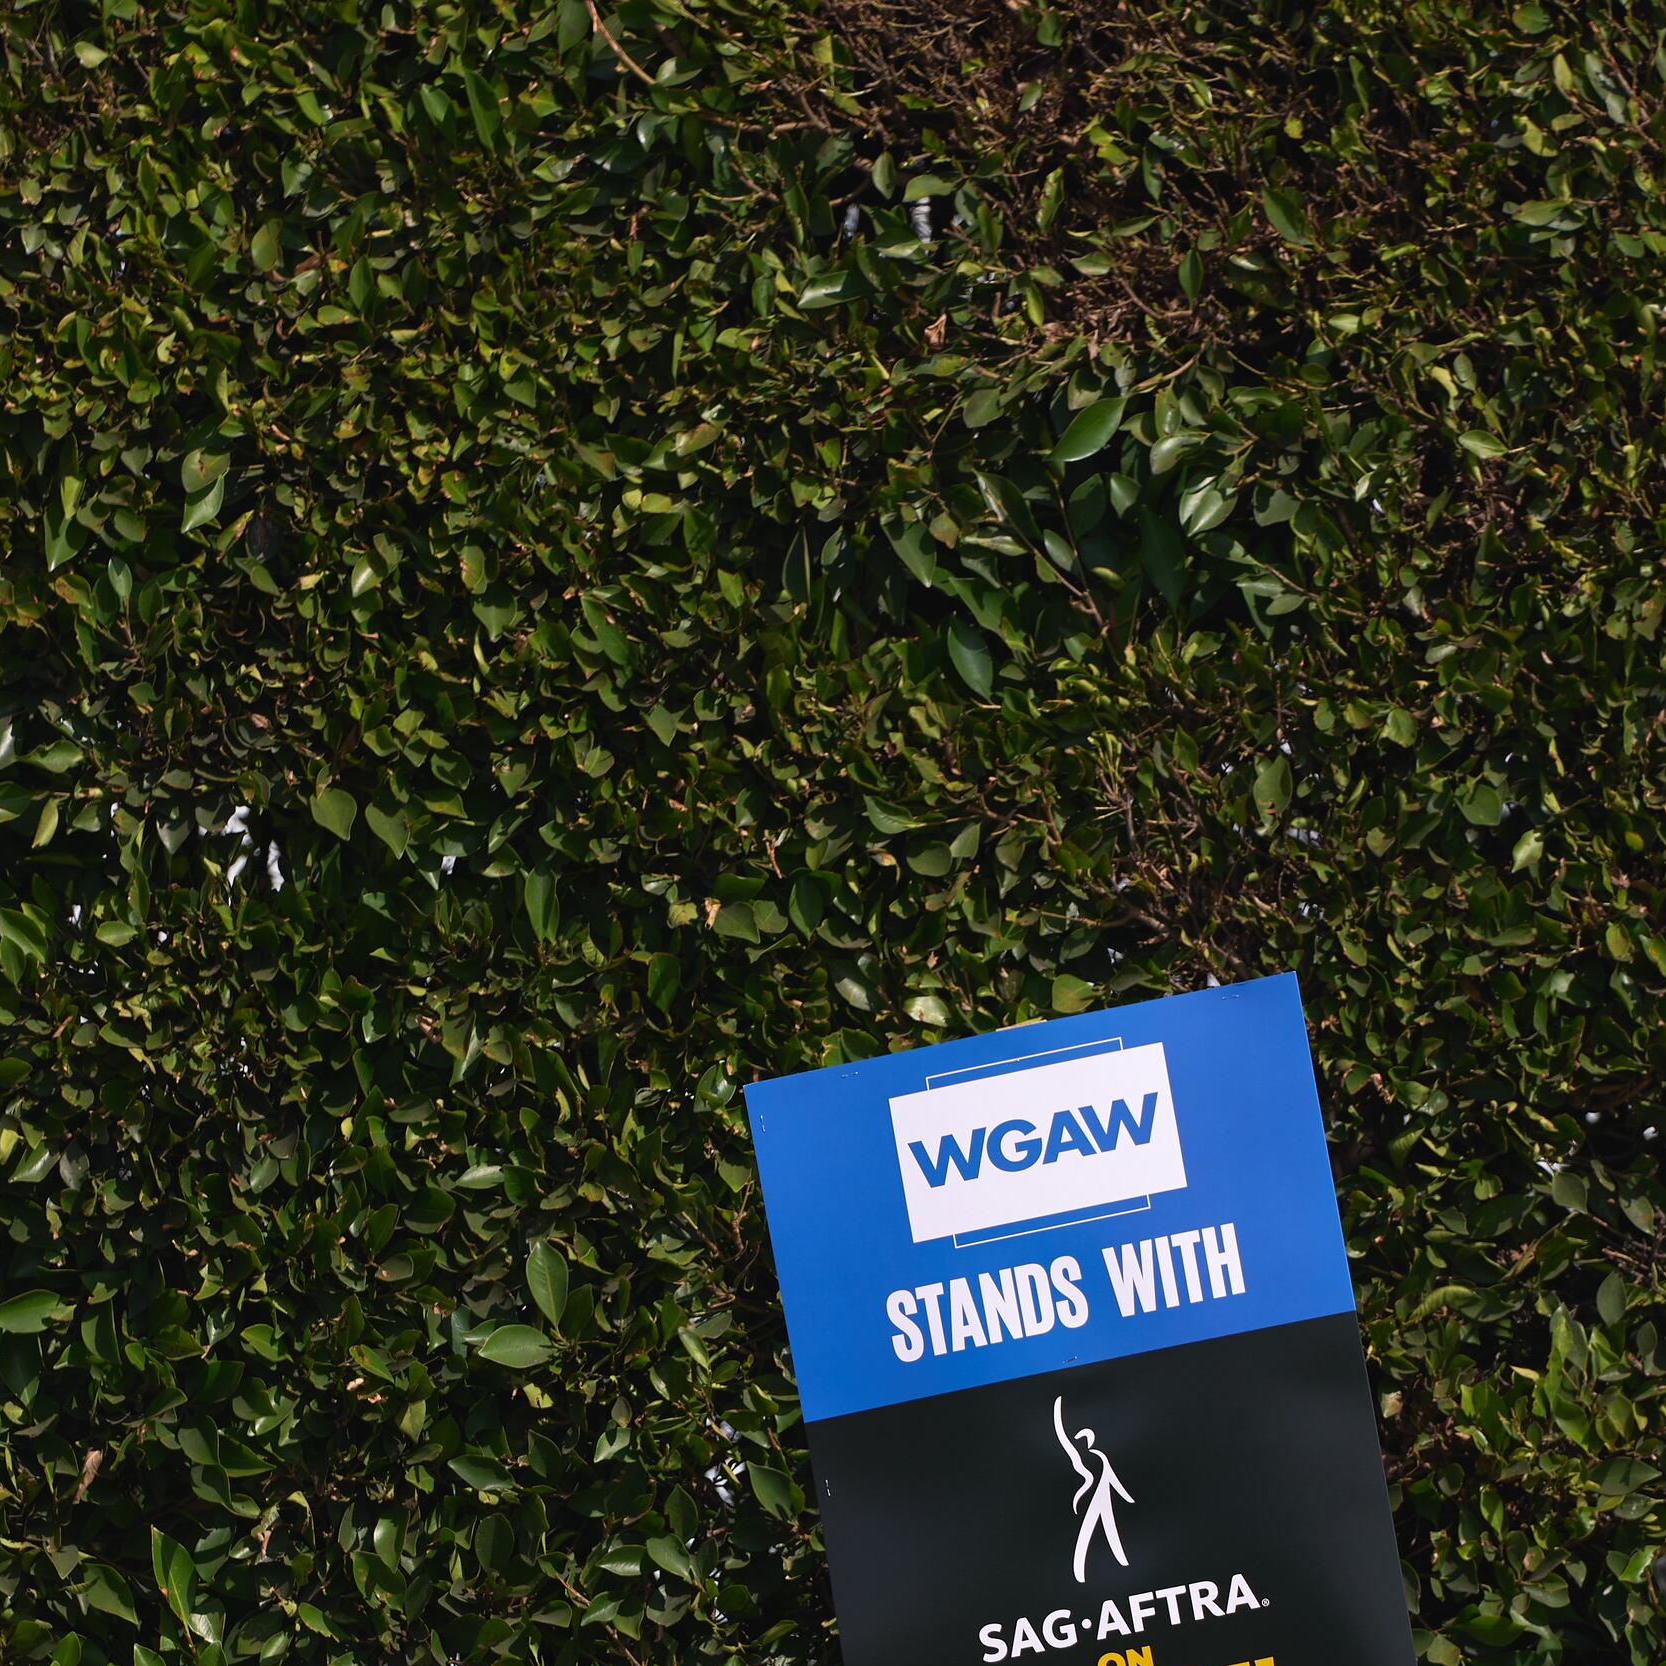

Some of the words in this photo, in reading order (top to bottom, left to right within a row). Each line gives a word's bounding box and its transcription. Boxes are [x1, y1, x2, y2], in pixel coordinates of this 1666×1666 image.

[907, 1091, 1159, 1189] WGAW
[886, 1254, 1089, 1362] STANDS
[1102, 1222, 1247, 1319] WITH
